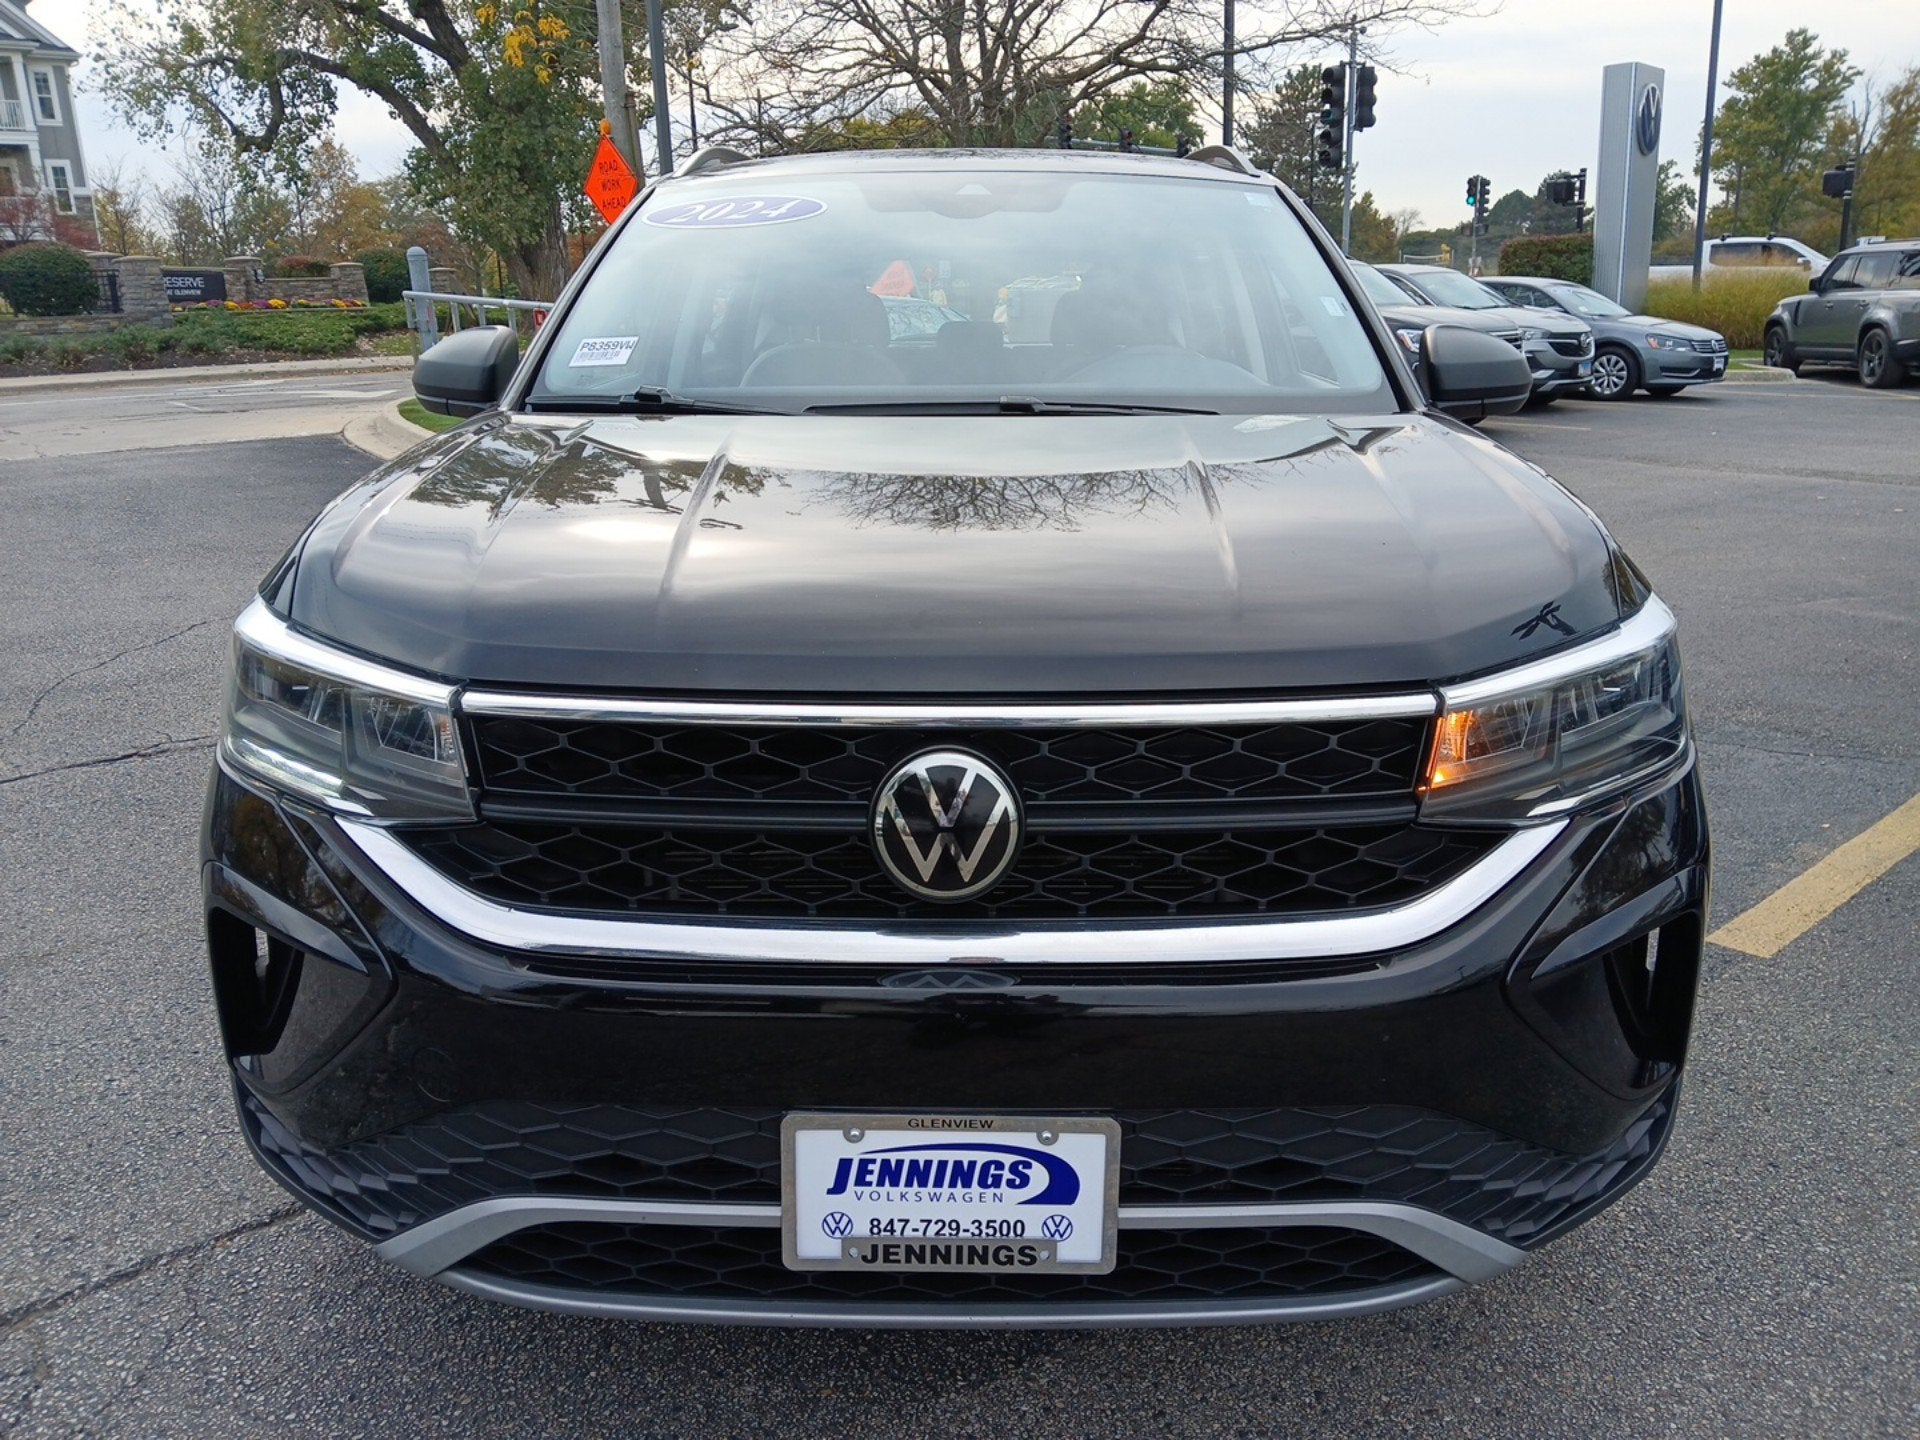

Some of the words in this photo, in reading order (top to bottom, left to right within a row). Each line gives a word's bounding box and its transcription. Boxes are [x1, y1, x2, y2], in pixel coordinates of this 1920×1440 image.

[599, 159, 618, 175] ROAD
[602, 179, 621, 192] WORK
[602, 196, 627, 210] AHEAD
[664, 199, 802, 224] 2024
[907, 1118, 994, 1129] GLENVIEW
[826, 1157, 1033, 1196] JENNINGS
[854, 1189, 1004, 1204] VOLKSWAGEN
[868, 1217, 1026, 1238] 847-729-3500
[860, 1243, 1038, 1267] JENNINGS
